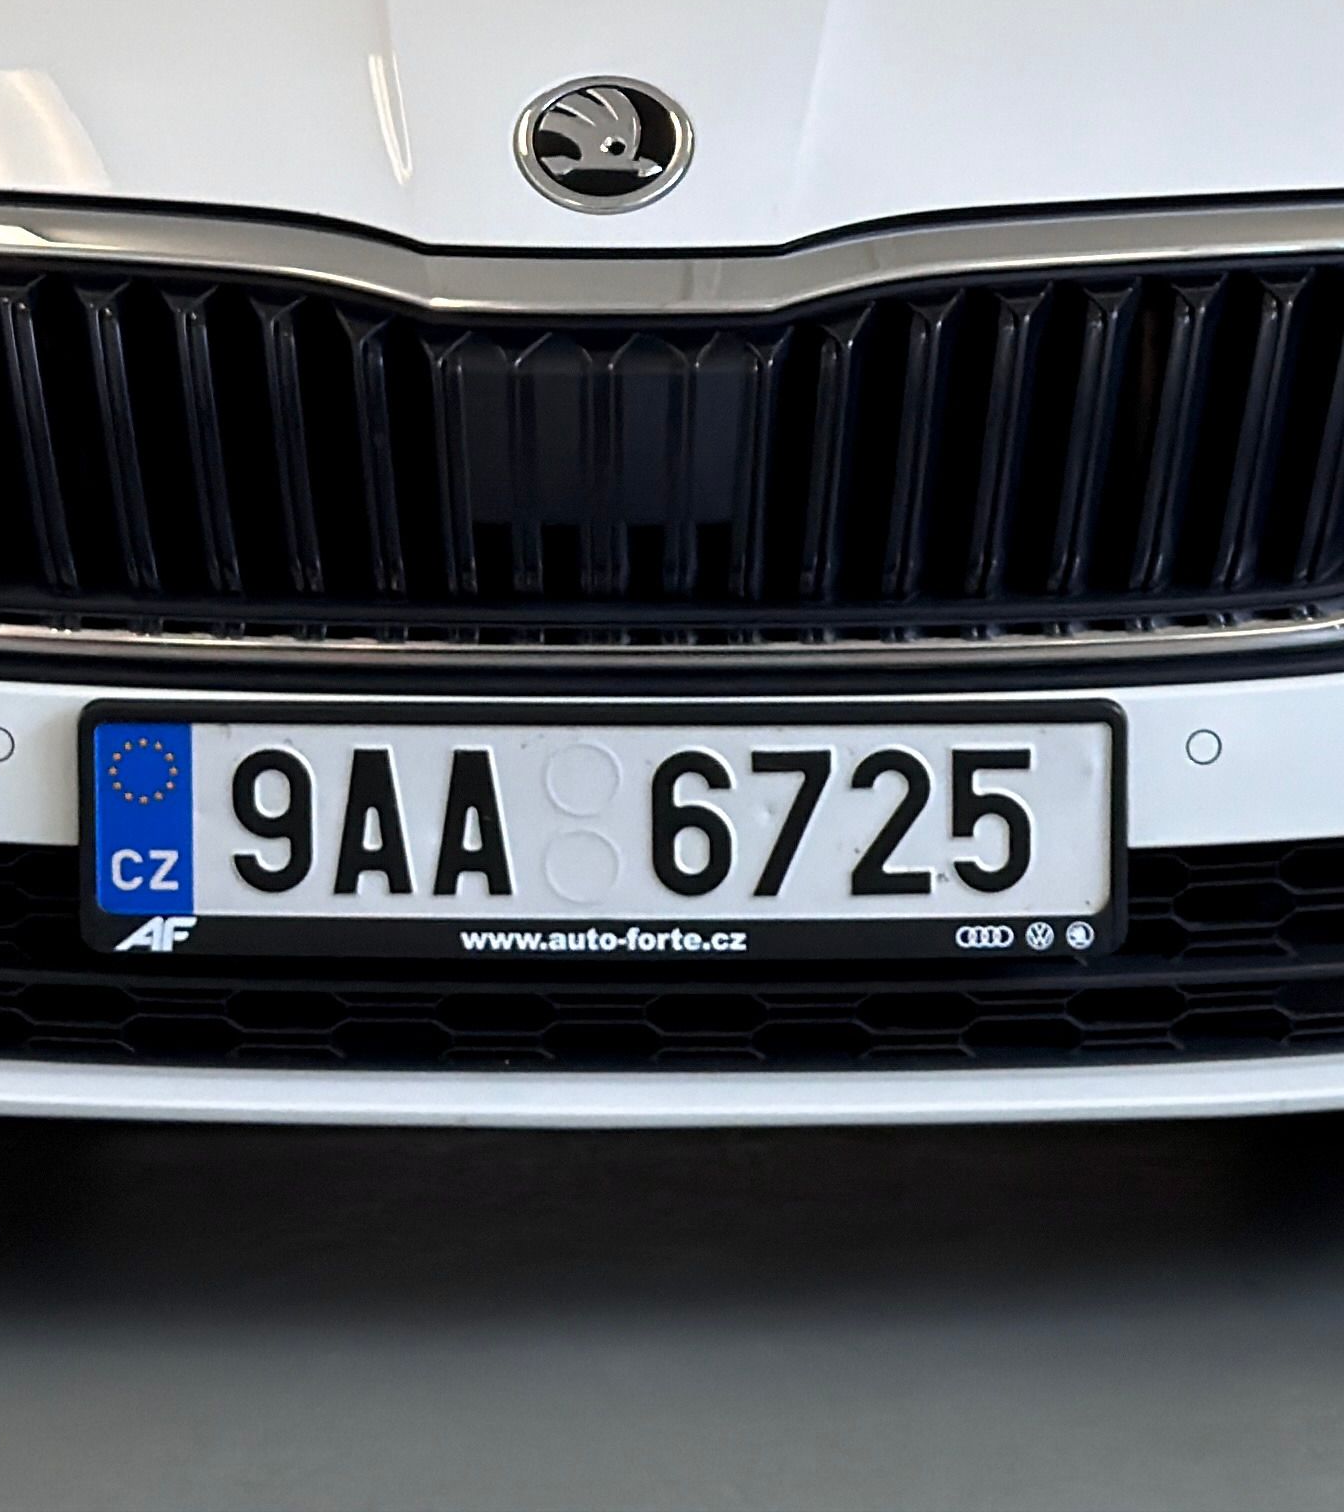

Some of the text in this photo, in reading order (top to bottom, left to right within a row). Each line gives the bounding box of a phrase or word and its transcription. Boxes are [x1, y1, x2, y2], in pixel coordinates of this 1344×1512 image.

[232, 746, 1032, 896] 9AA 6725
[111, 848, 179, 891] CZ
[114, 915, 197, 952] AF
[460, 927, 747, 951] www.auto-forte.cz
